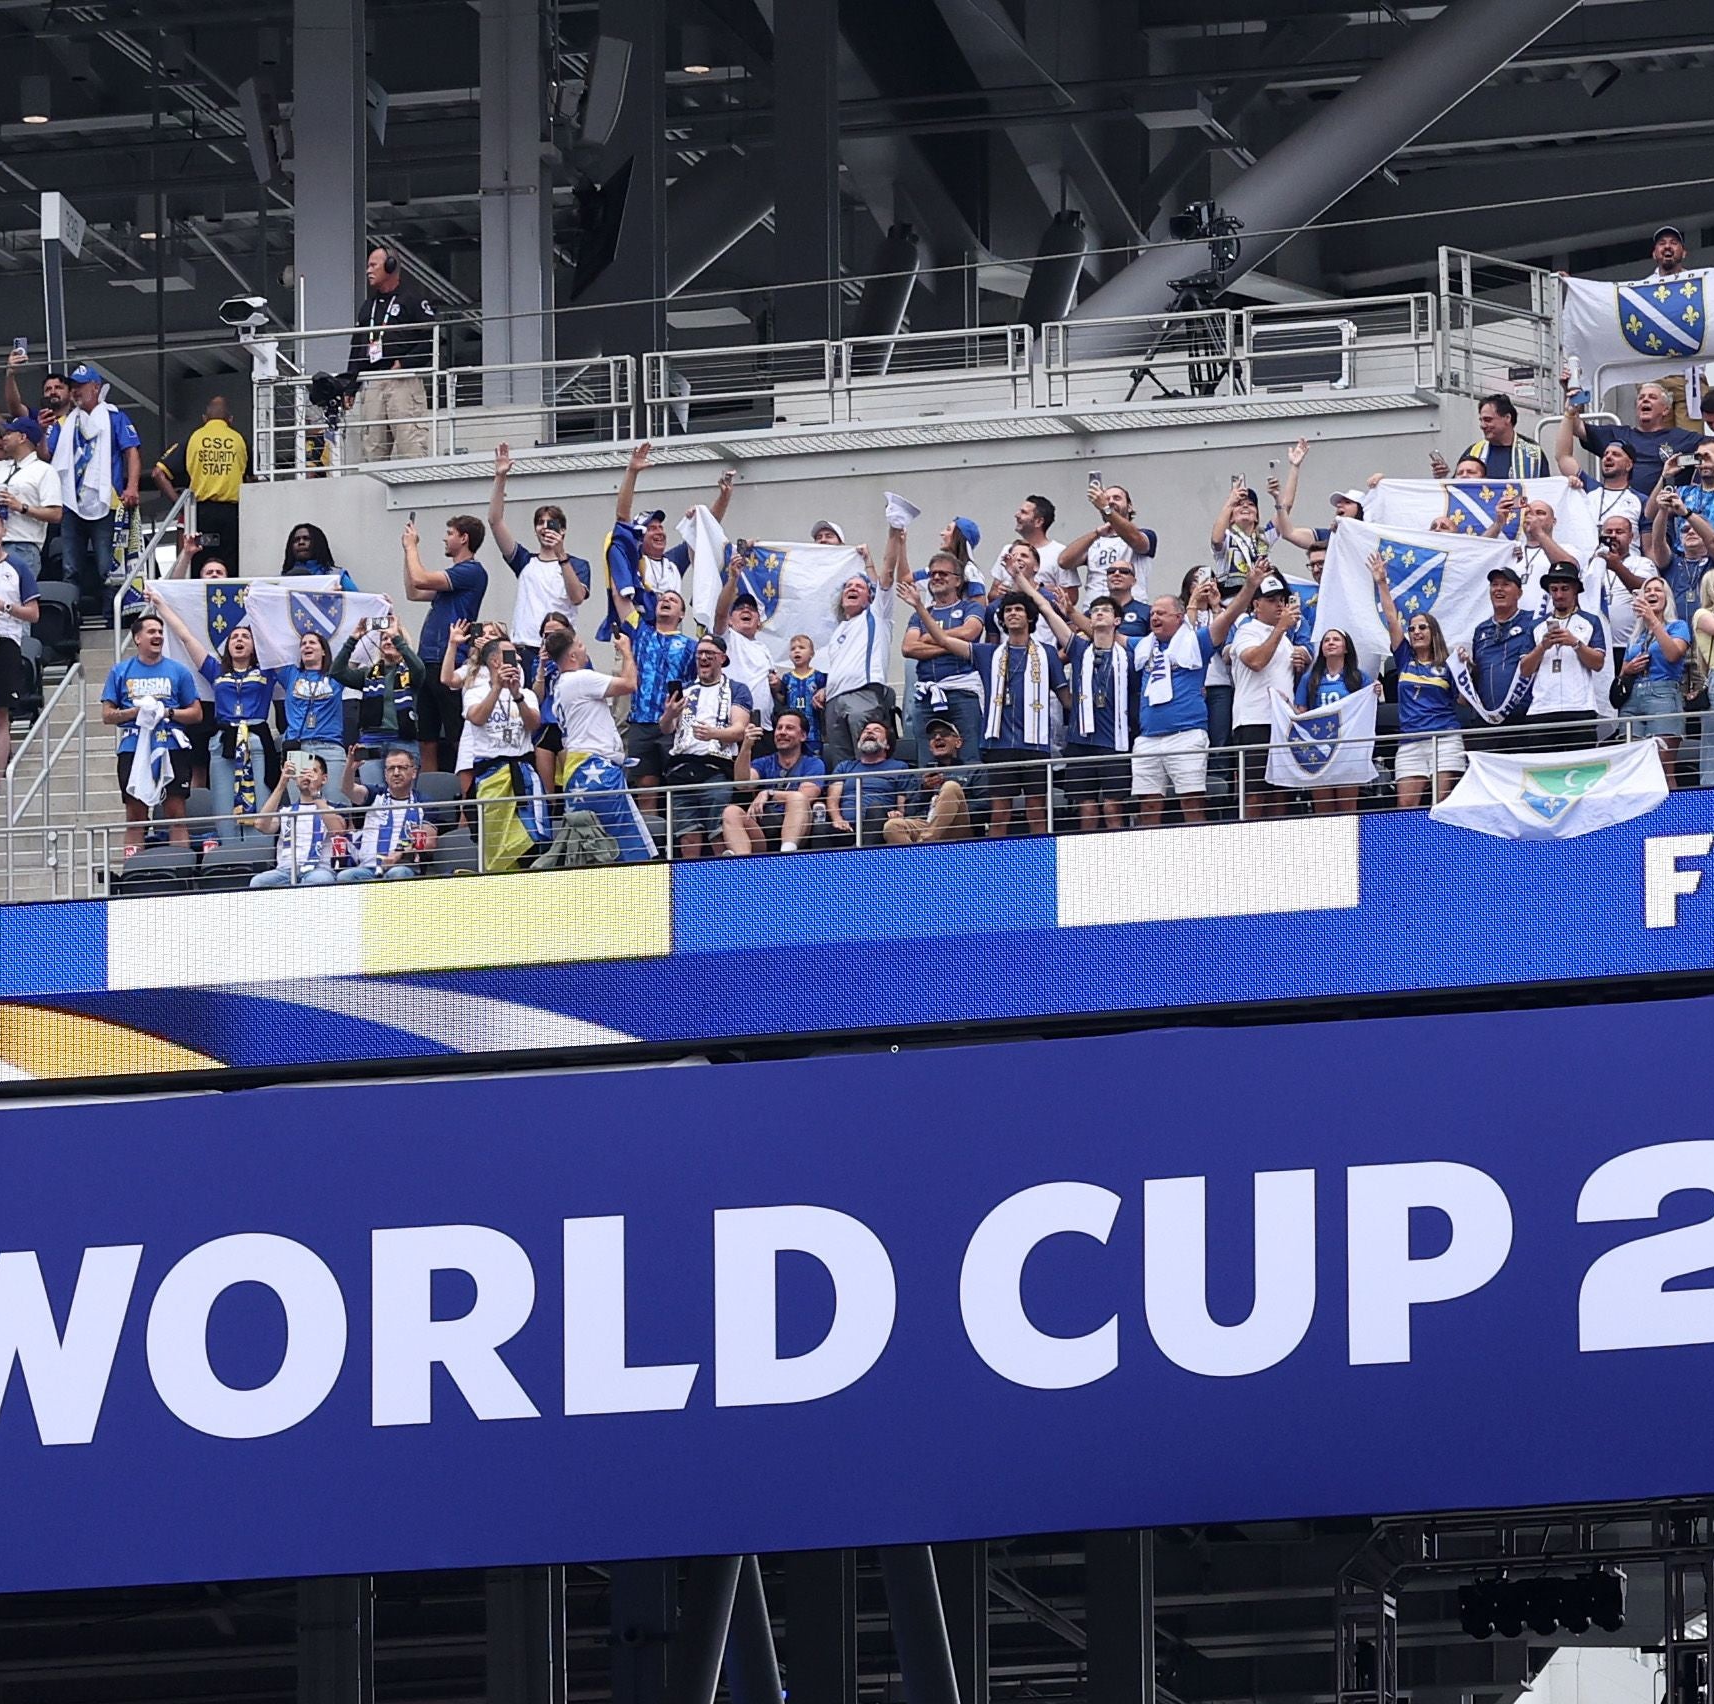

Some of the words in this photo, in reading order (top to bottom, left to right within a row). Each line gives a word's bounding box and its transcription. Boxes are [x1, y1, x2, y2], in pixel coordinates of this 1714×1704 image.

[202, 438, 234, 449] CSC
[198, 450, 237, 463] SECURITY
[202, 464, 231, 476] STAFF
[1099, 549, 1117, 566] 26
[960, 1162, 1512, 1388] CUP
